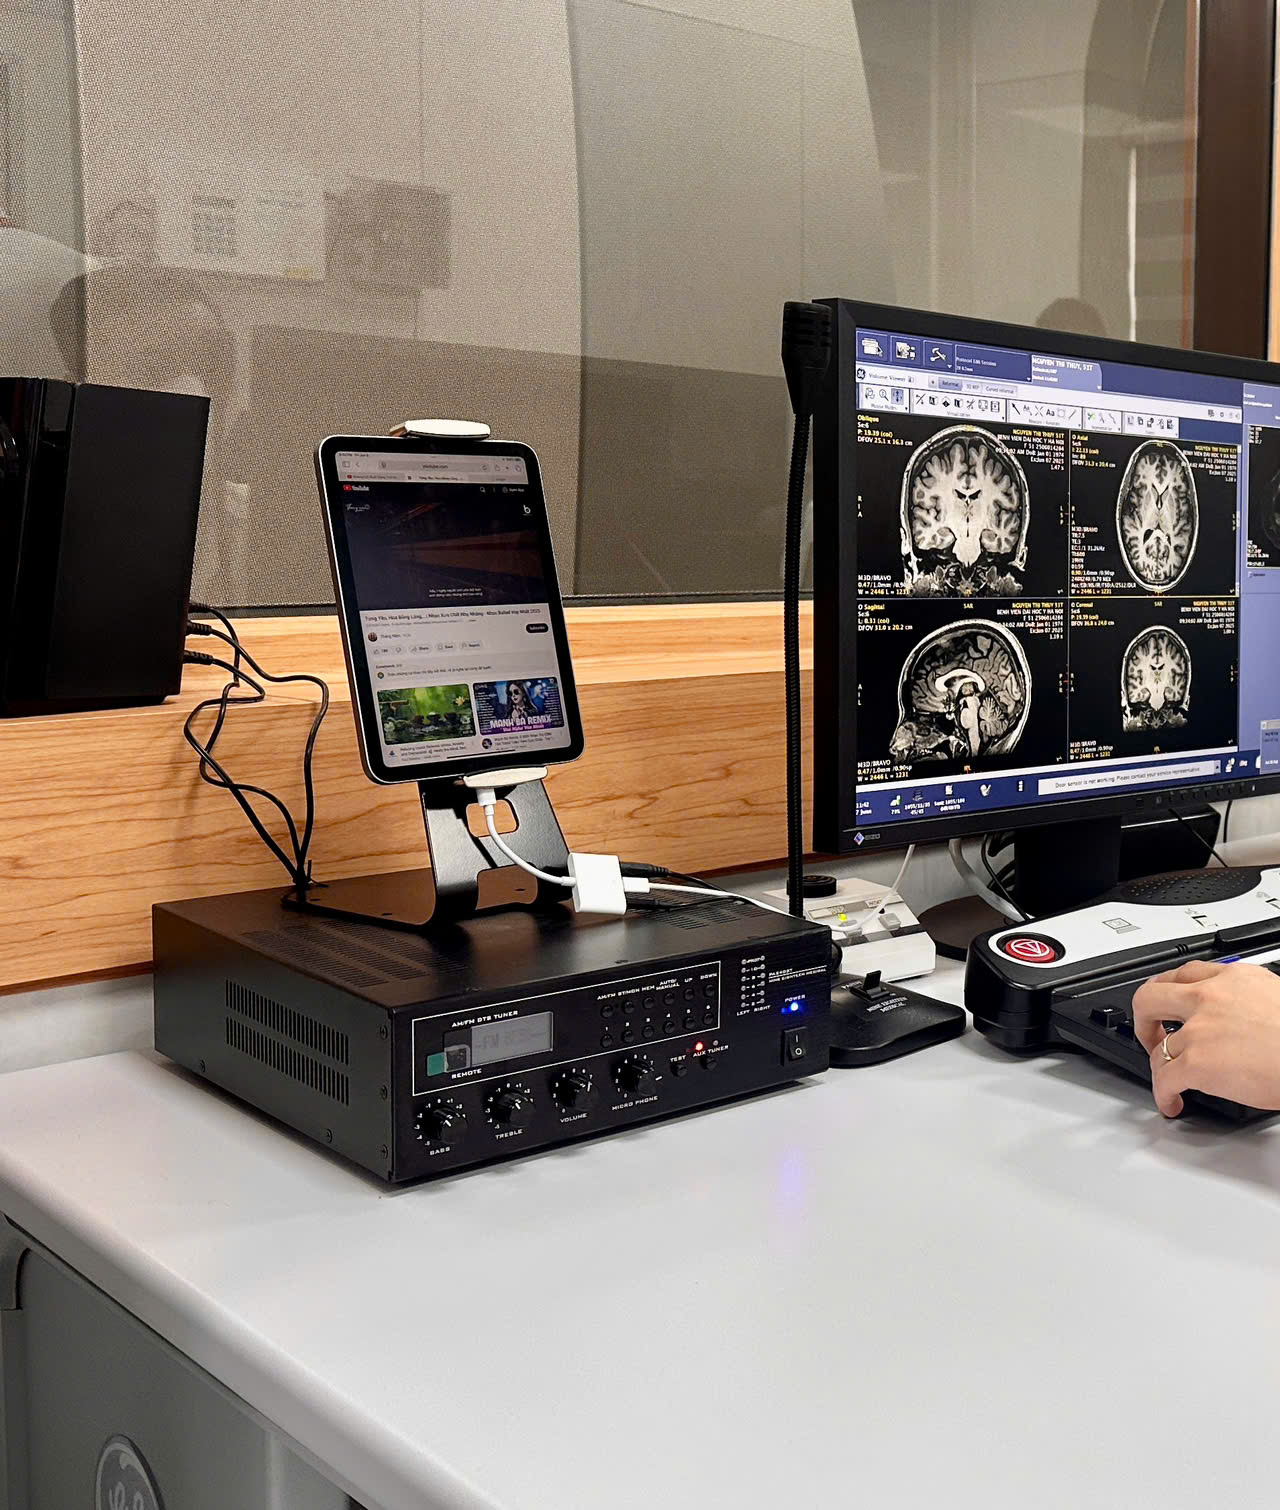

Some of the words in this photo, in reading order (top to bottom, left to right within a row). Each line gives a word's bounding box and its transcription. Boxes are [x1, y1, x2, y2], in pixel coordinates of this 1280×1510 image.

[858, 415, 879, 423] Oblique
[785, 994, 805, 1002] POWER
[452, 1019, 474, 1028] AM/FM
[494, 1010, 518, 1020] TUNER
[708, 1045, 729, 1054] TUNER
[452, 1068, 482, 1079] REMOTE
[612, 1102, 633, 1111] MICRO
[635, 1096, 658, 1105] PHONE
[560, 1113, 588, 1123] VOLUME
[495, 1129, 522, 1139] TREBLE
[430, 1146, 450, 1155] BASS
